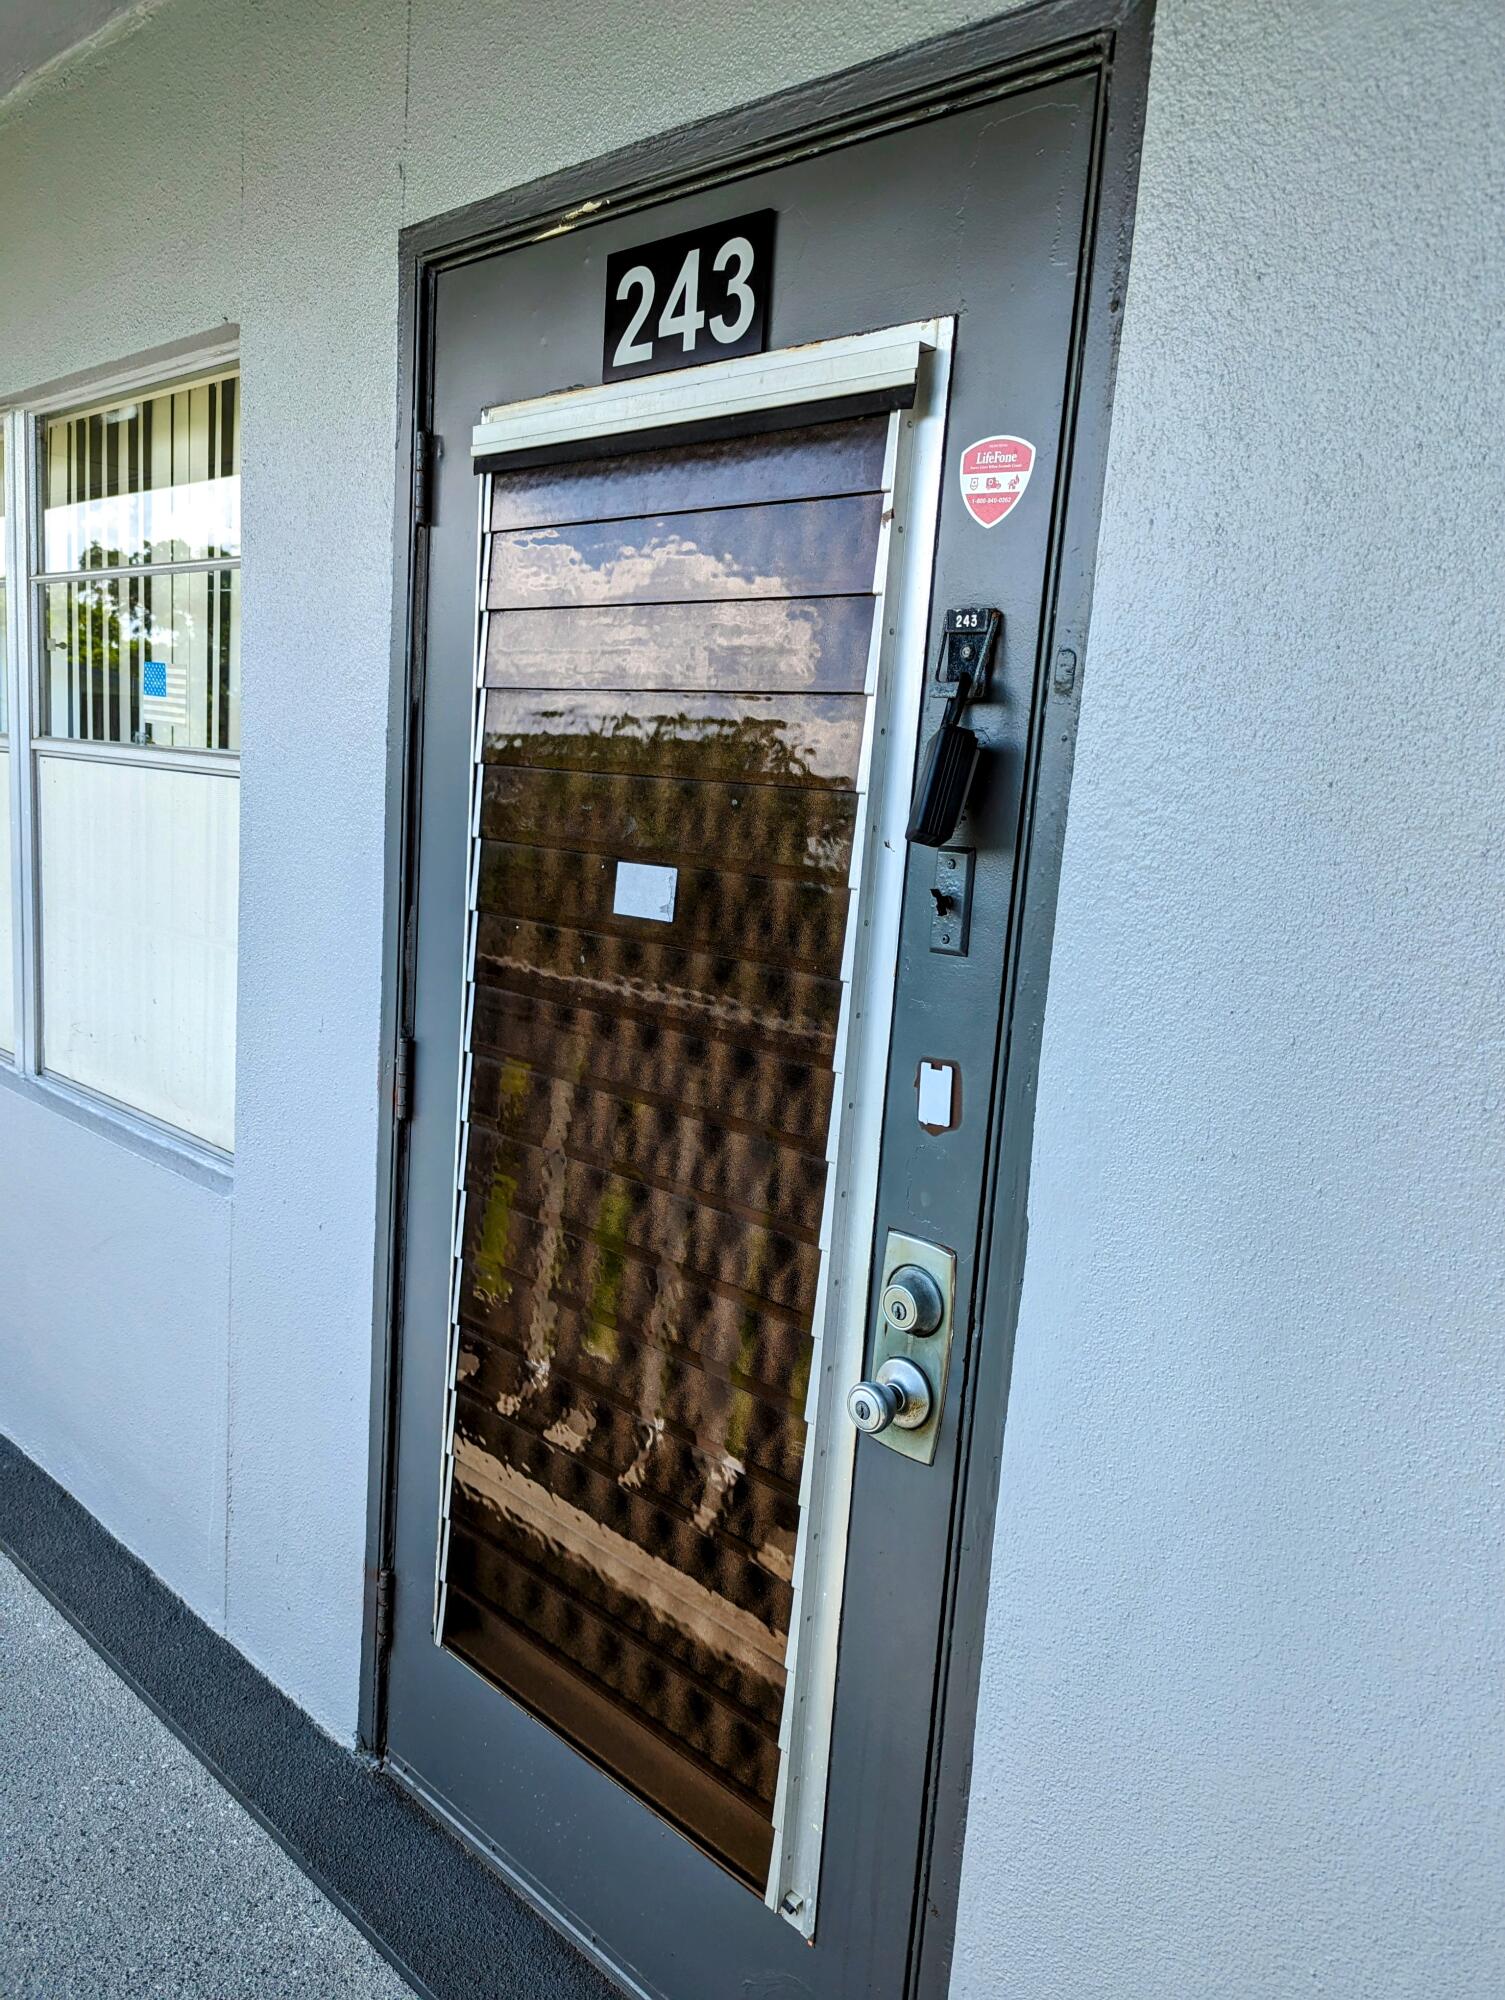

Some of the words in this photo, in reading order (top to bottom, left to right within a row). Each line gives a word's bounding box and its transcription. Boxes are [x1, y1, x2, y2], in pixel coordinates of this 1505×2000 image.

[612, 237, 755, 367] 243
[976, 451, 1018, 464] LifeFone
[956, 614, 978, 628] 243
